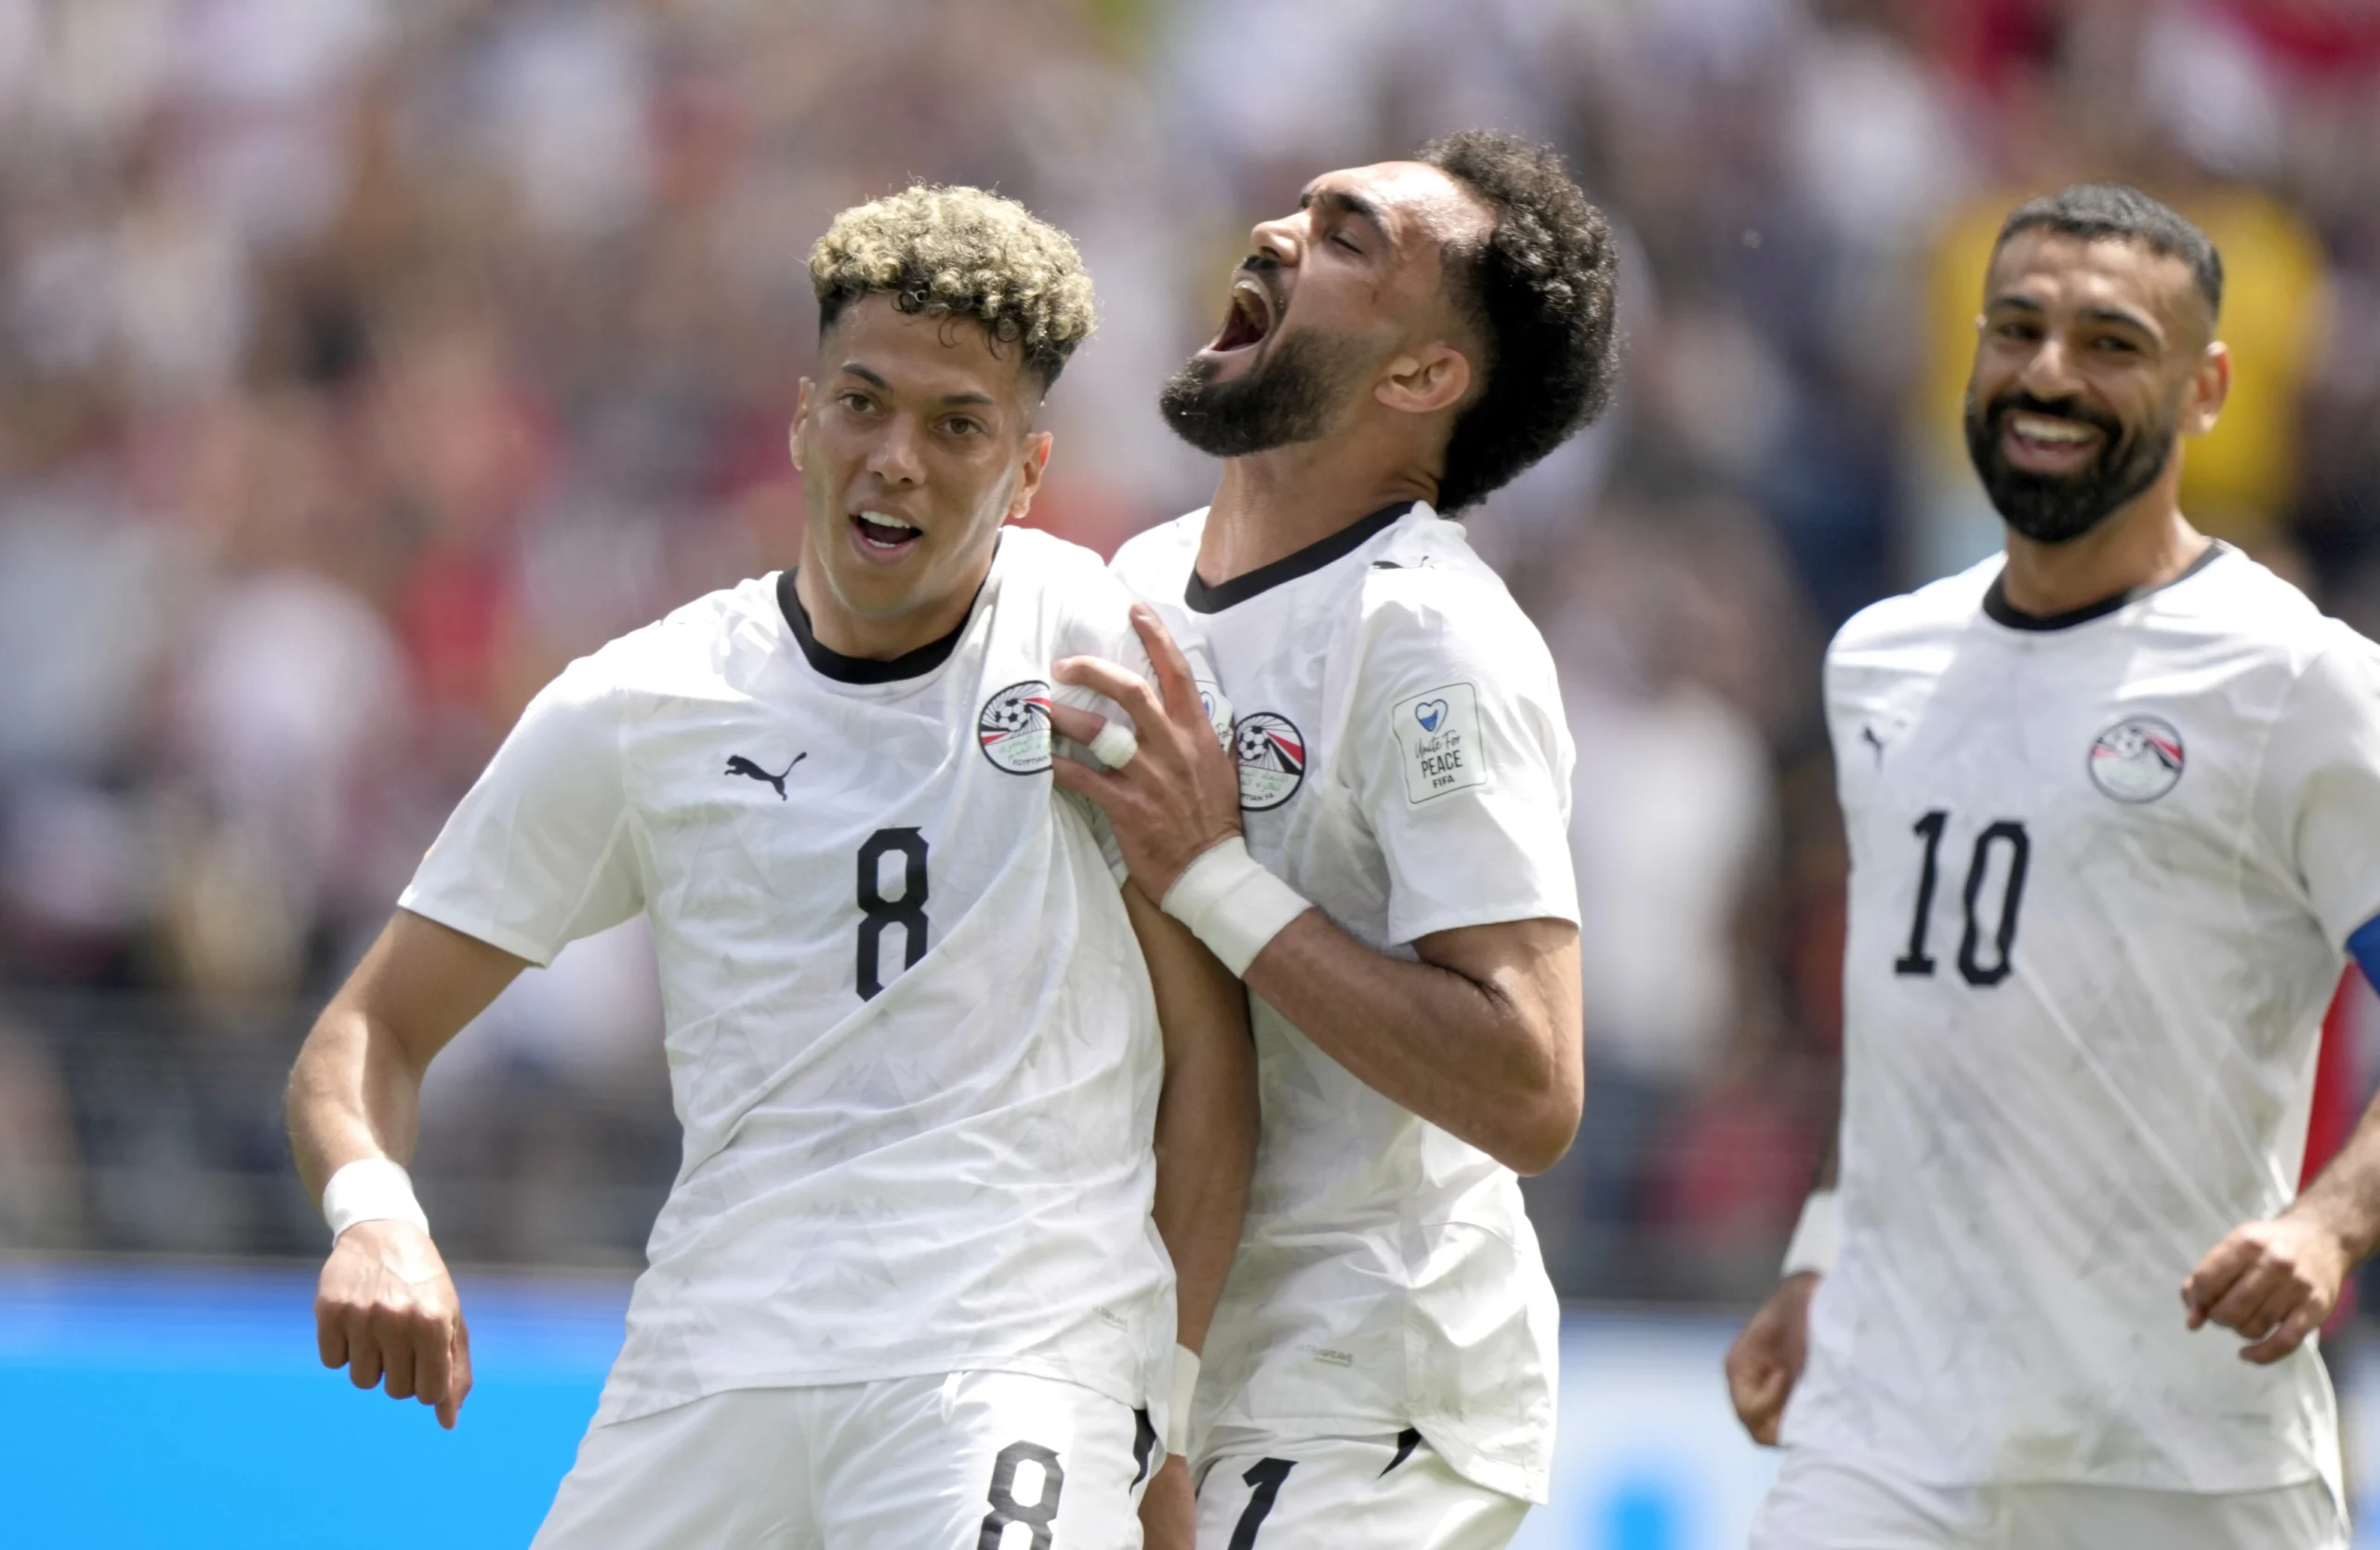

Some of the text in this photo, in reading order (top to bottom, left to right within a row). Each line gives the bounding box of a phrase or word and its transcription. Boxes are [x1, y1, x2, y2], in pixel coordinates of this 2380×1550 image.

[1415, 729, 1461, 759] Unite For
[1421, 749, 1463, 778] PEACE
[1432, 775, 1455, 788] FIFA
[856, 827, 929, 1002] 8
[1895, 810, 2030, 986] 10
[978, 1439, 1065, 1550] 8
[1228, 1457, 1299, 1550] 1
